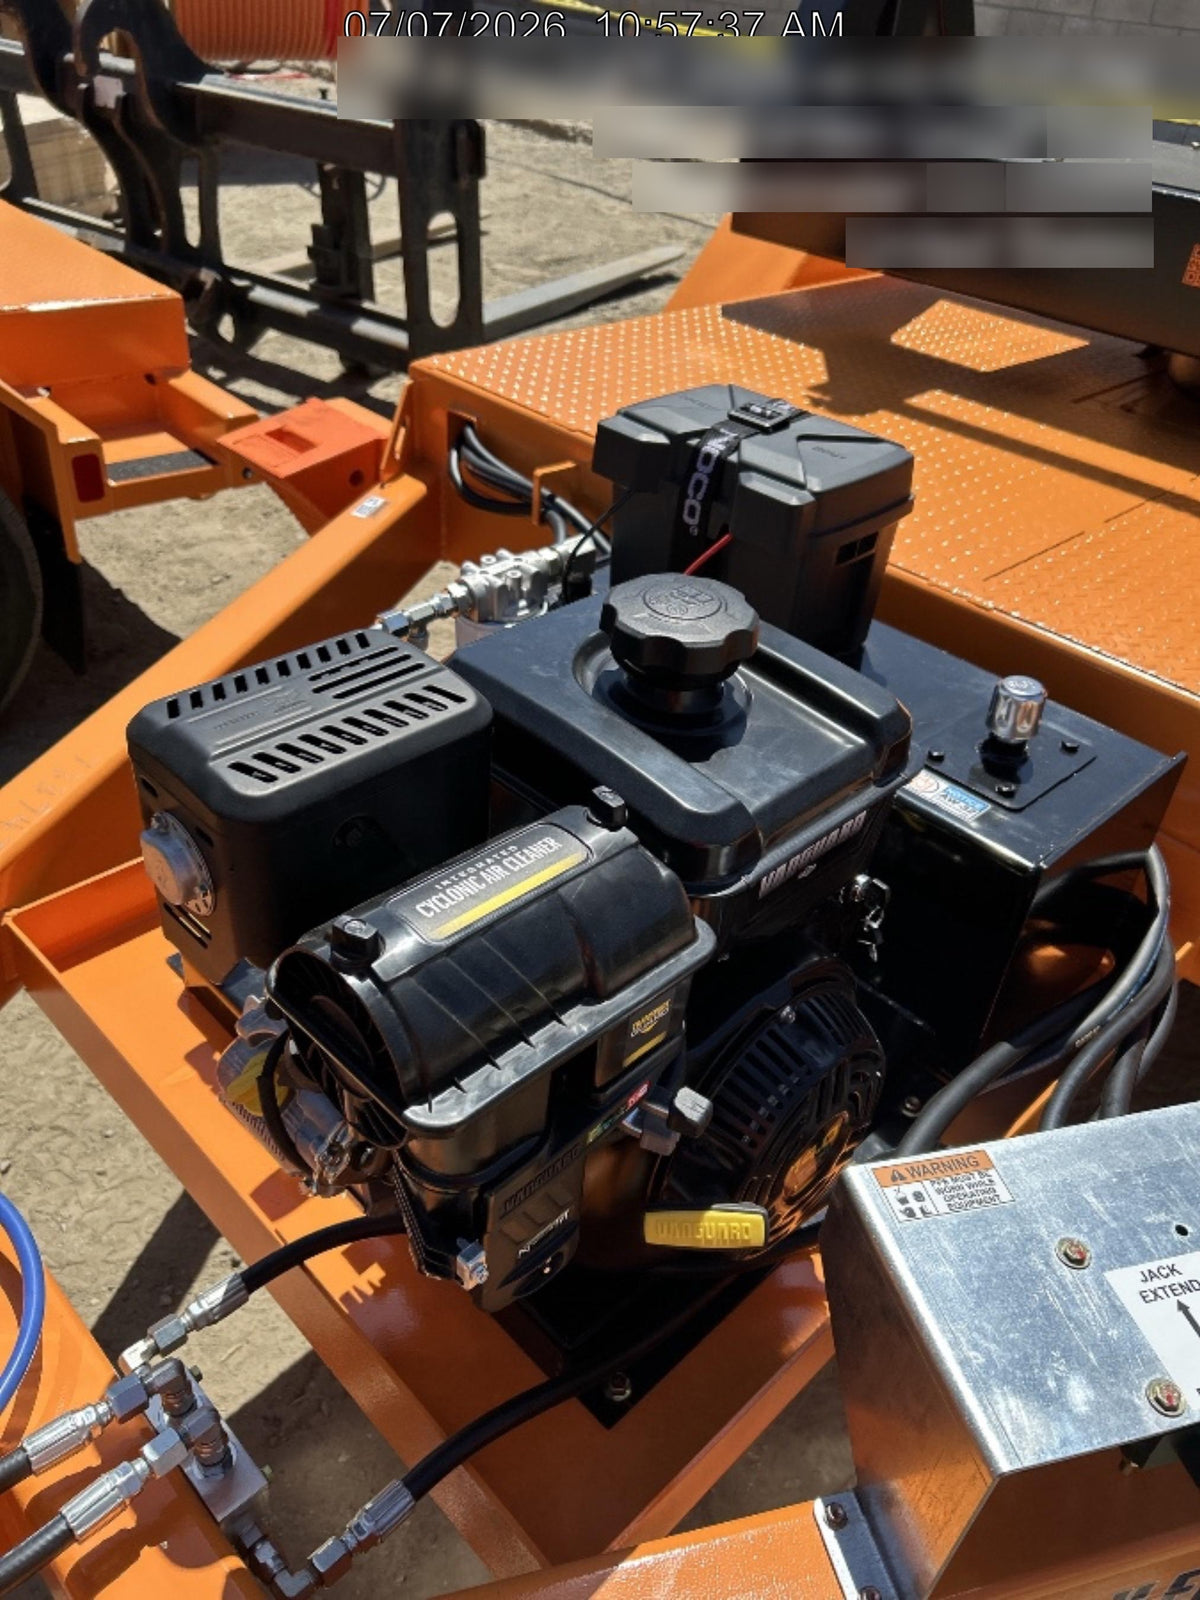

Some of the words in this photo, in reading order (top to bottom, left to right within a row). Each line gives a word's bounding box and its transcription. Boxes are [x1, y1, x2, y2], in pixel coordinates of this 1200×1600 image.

[415, 875, 486, 918] CYCLONIC
[480, 864, 511, 884] AIR
[502, 836, 563, 872] CLEANER
[435, 845, 518, 890] INTEGRATED
[905, 1155, 980, 1179] WARNING
[1140, 1263, 1183, 1283] JACK
[1139, 1279, 1200, 1304] EXTEND
